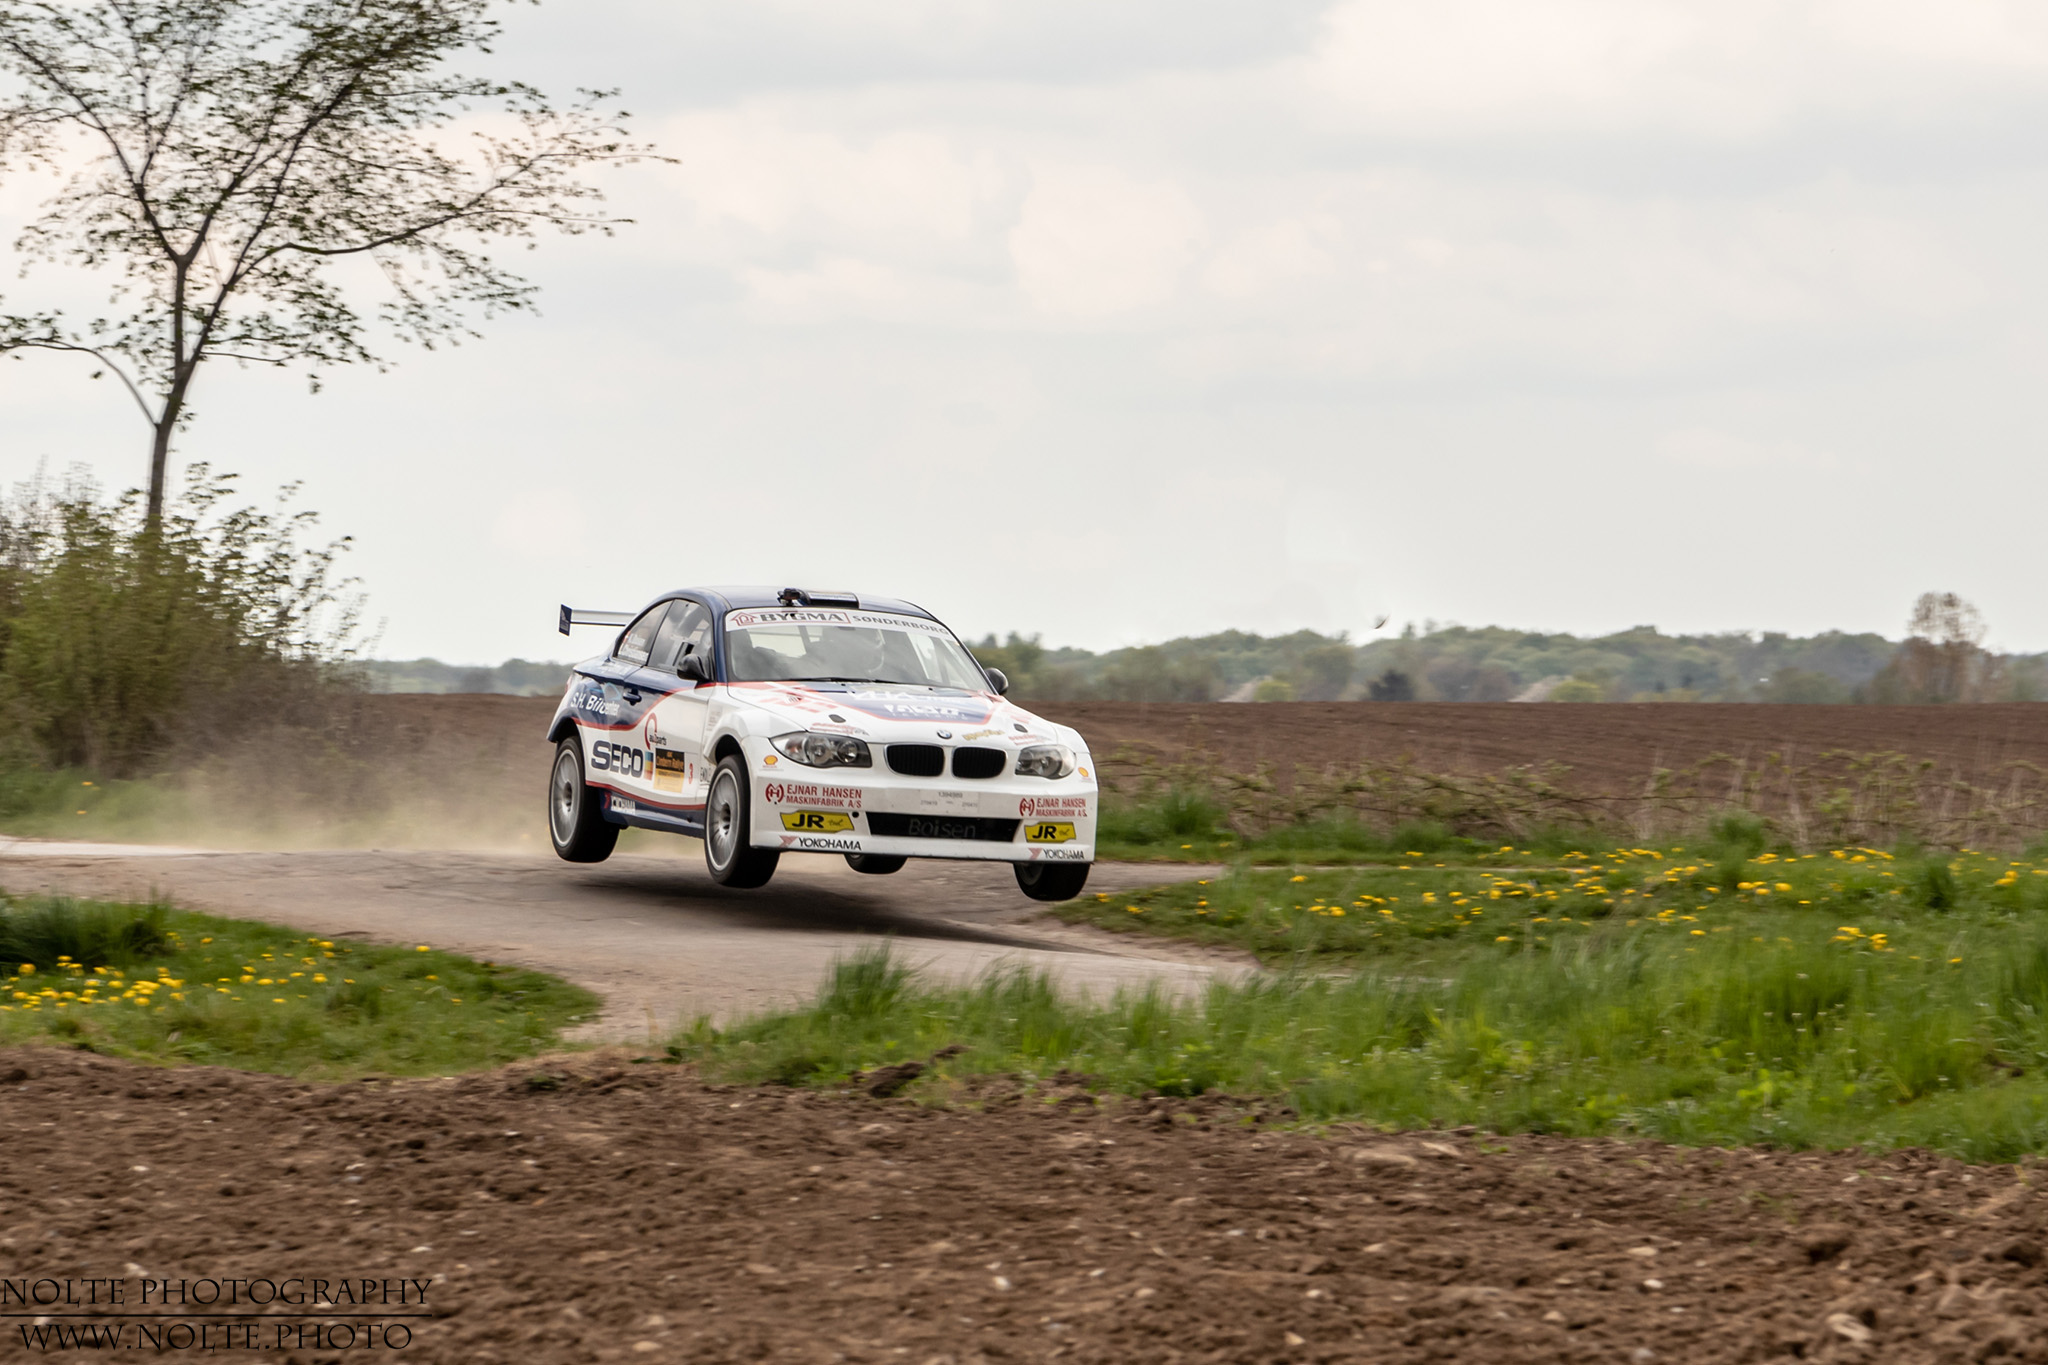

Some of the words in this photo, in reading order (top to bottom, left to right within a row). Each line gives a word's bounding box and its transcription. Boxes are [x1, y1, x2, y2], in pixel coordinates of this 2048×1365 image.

[759, 612, 845, 623] BYGMA
[852, 615, 949, 635] SØNDERBORG
[591, 740, 644, 778] SECO
[786, 784, 818, 796] EJNAR
[822, 787, 862, 799] HANSEN
[785, 795, 844, 807] MASKINFABRIK
[847, 799, 862, 808] A/S
[1036, 798, 1060, 808] EJNAR
[1062, 798, 1086, 808] HANSEN
[791, 813, 825, 829] JR
[908, 817, 976, 838] Boisen
[1031, 825, 1058, 839] JR
[798, 837, 862, 851] YOKOHAMA
[1043, 848, 1085, 860] YOKOHAMA
